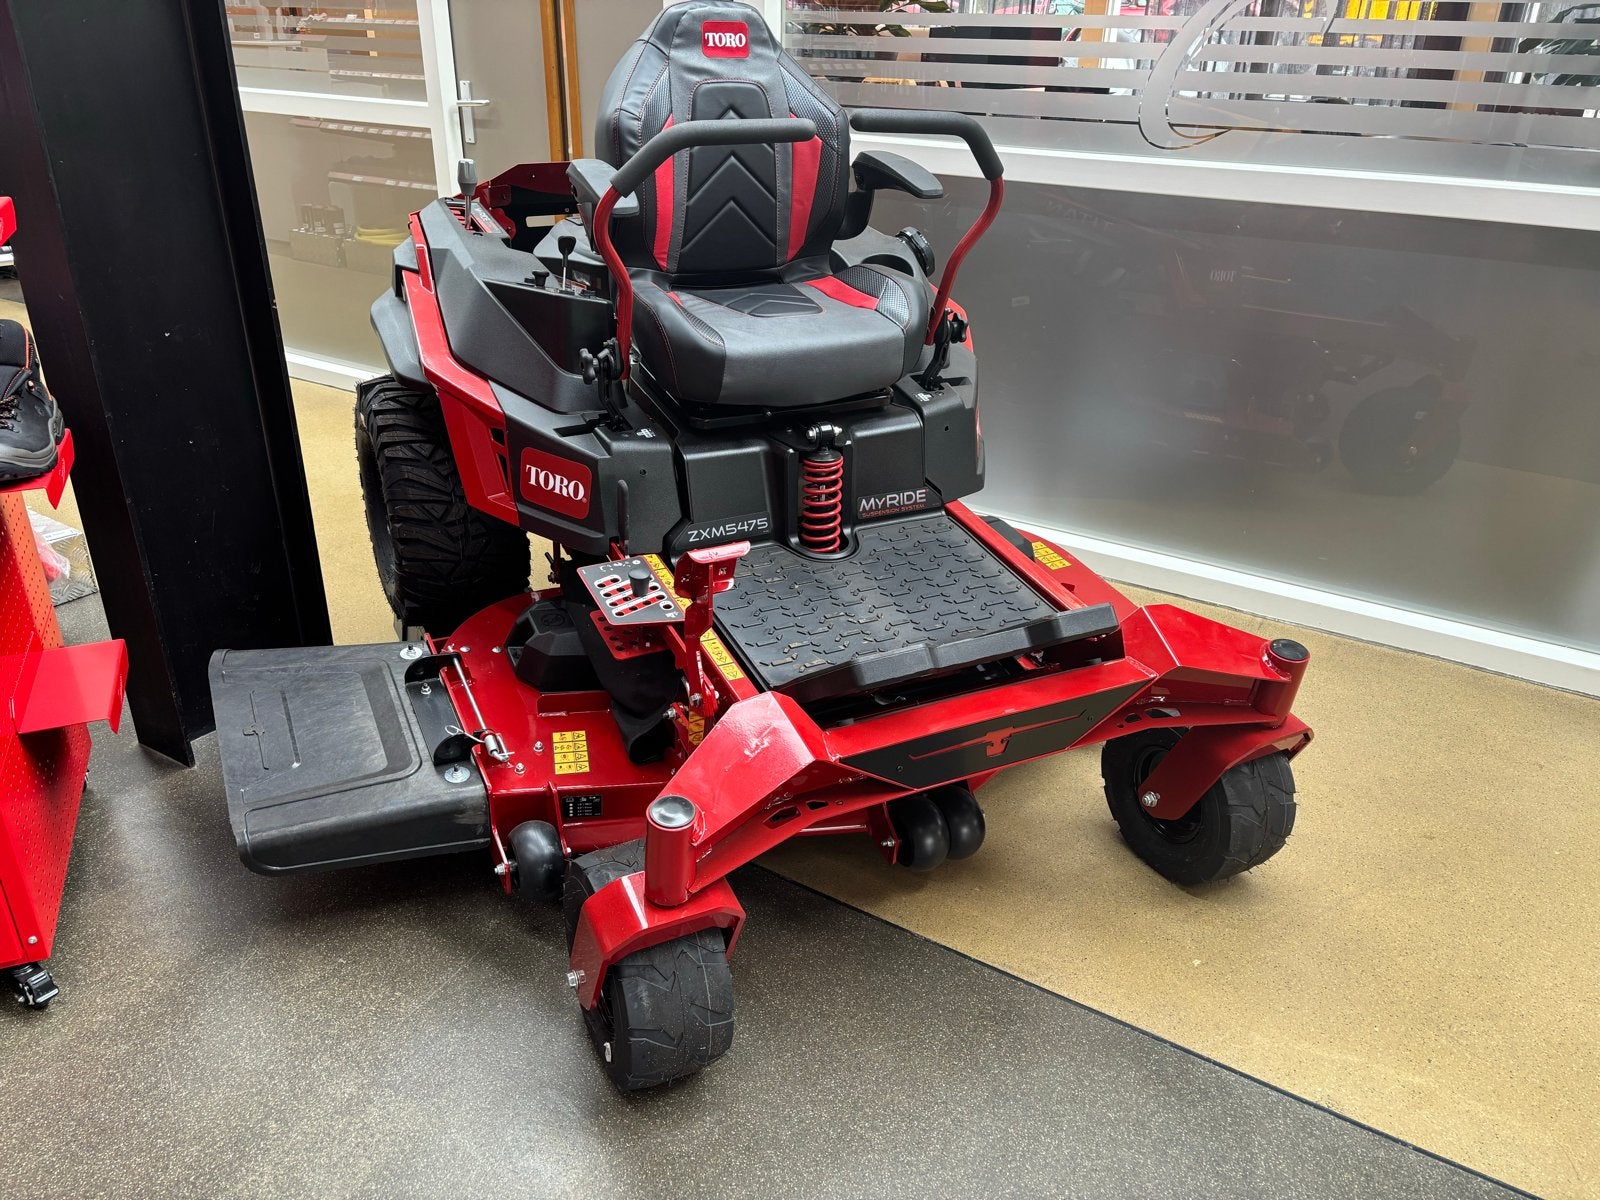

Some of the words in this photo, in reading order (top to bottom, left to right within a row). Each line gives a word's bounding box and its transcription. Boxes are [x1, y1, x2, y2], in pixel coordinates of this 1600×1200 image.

[704, 32, 747, 48] TORO
[525, 464, 585, 501] TORO
[862, 507, 900, 518] SUSPENSION
[901, 503, 926, 512] SYSTEM
[687, 517, 769, 542] ZXM5475
